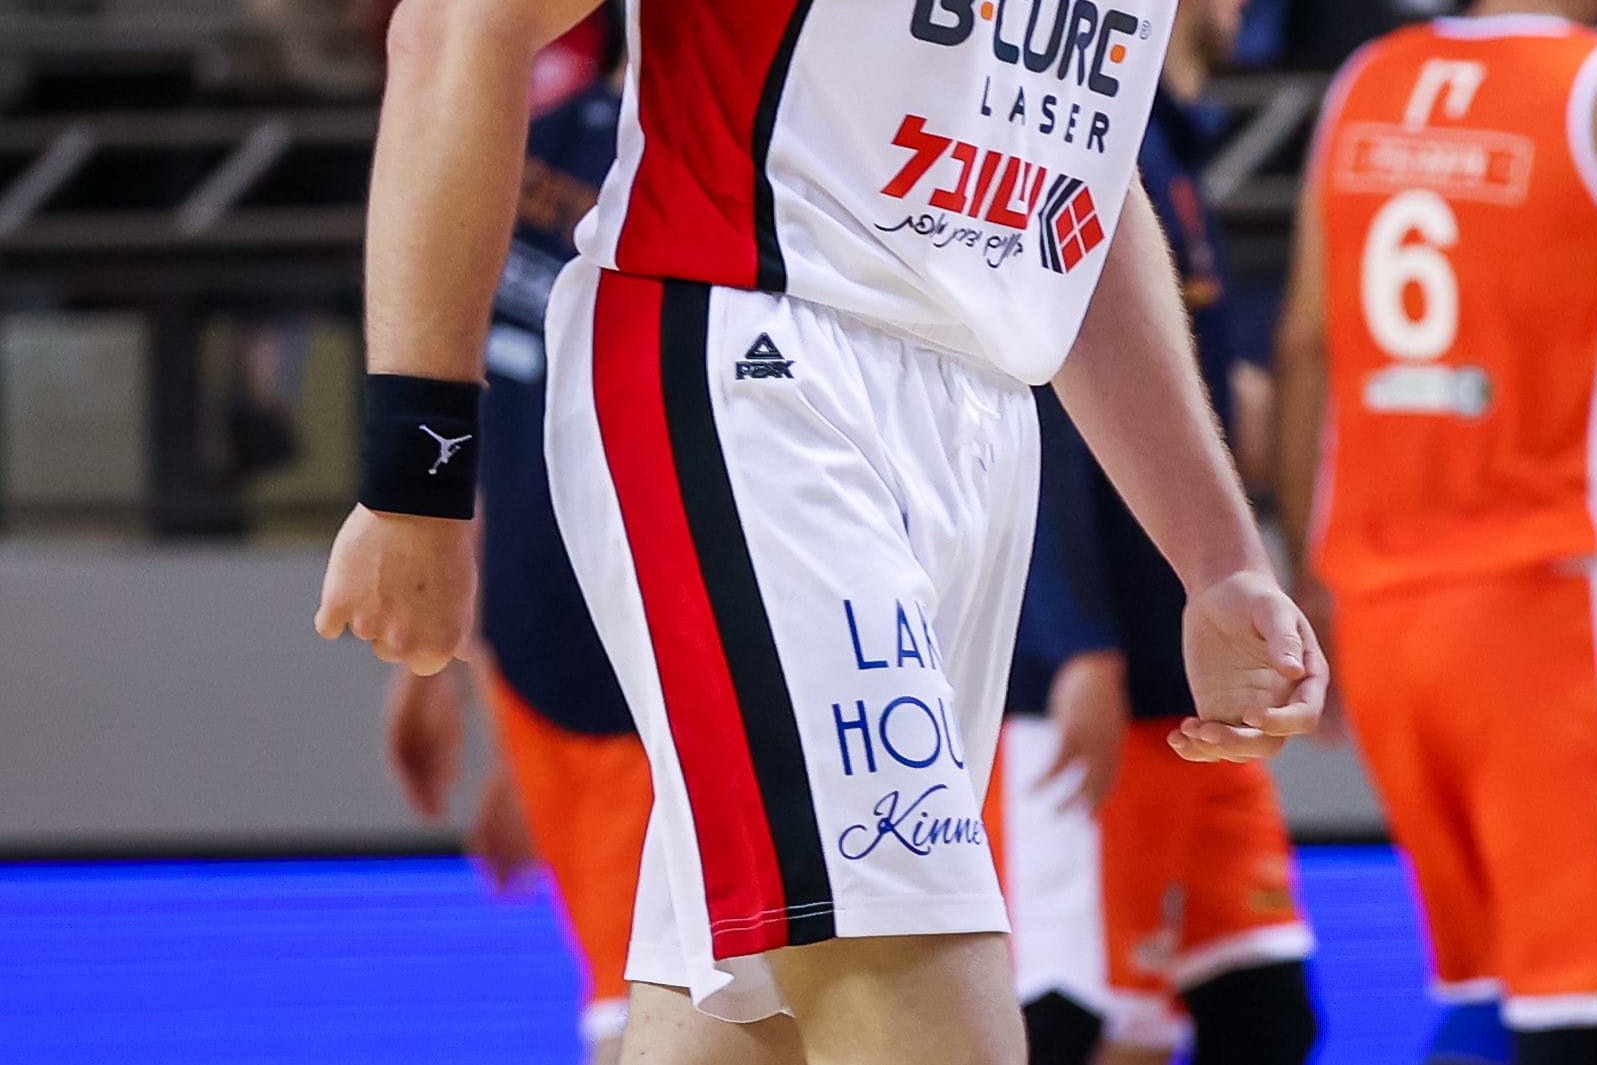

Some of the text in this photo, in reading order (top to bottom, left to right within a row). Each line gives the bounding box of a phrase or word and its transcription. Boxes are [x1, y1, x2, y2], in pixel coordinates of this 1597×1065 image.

[980, 76, 1110, 154] LASER
[880, 114, 1047, 230] שובל
[1362, 190, 1460, 363] 6
[832, 695, 964, 776] HOU
